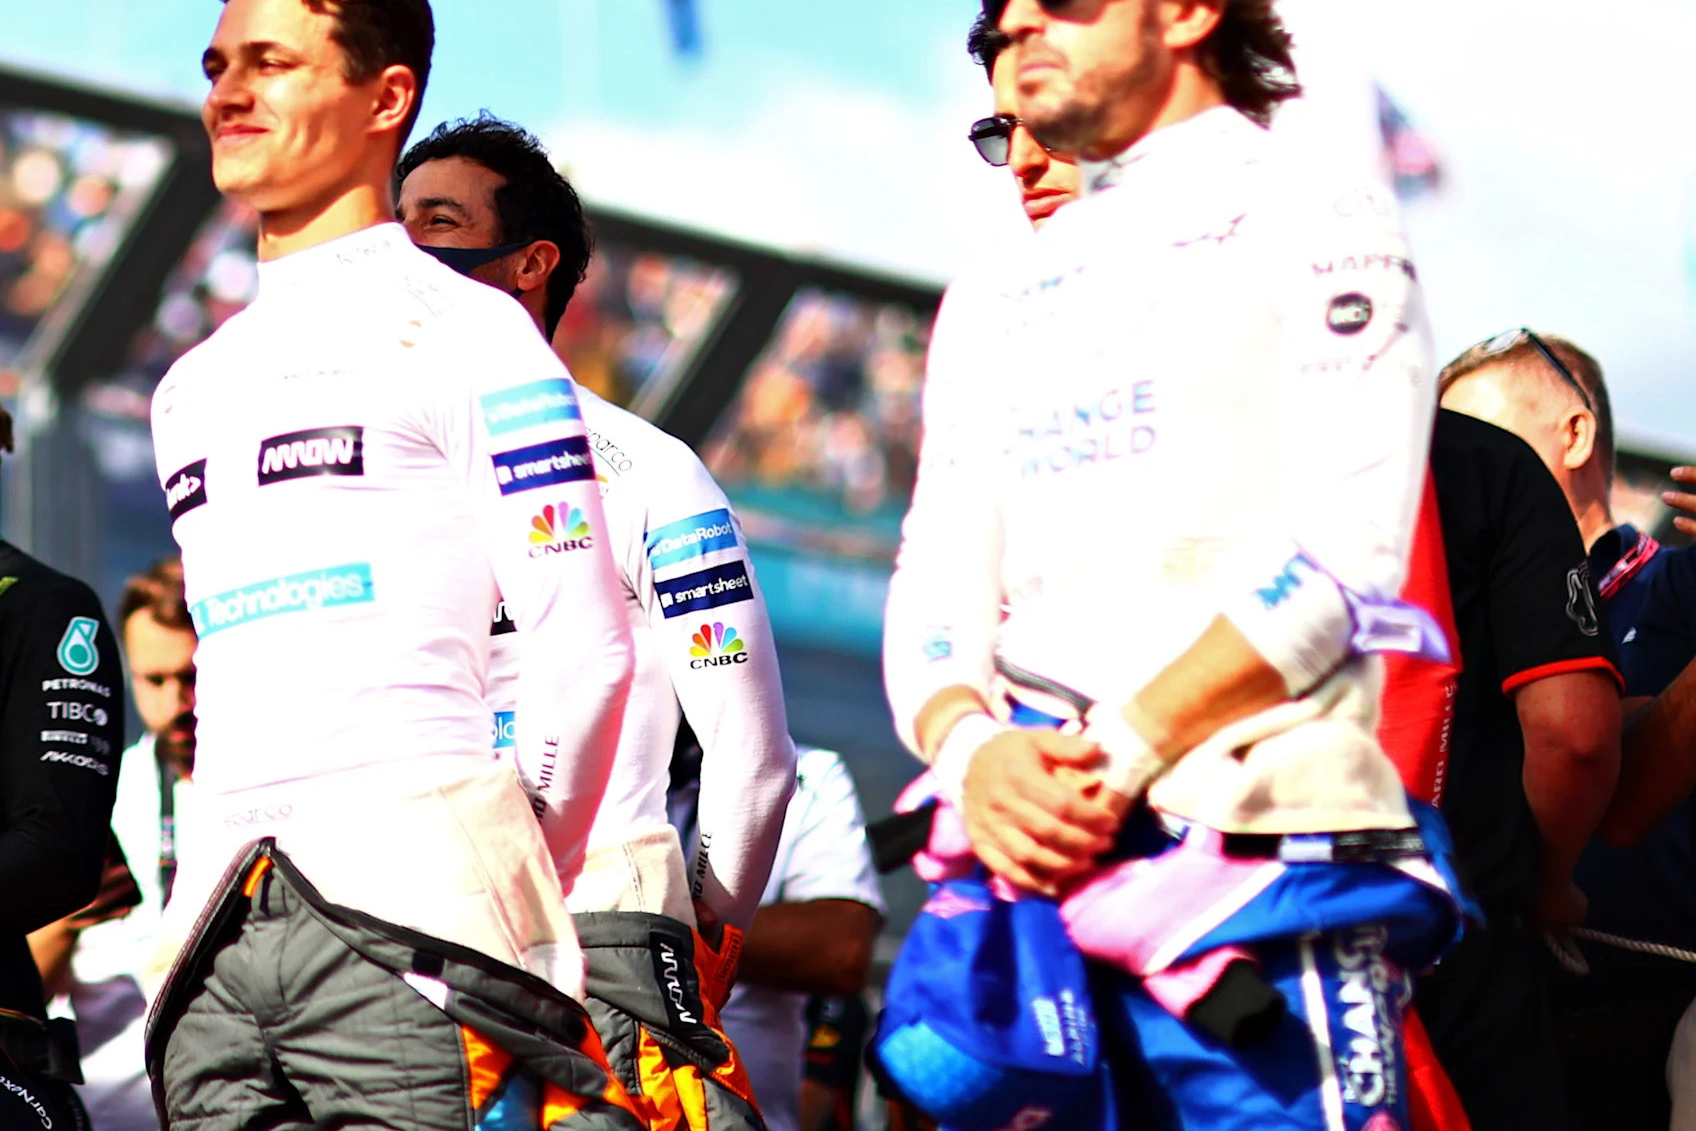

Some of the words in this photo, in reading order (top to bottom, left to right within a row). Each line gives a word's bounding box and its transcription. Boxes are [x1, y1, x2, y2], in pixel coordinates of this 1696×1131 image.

[528, 536, 594, 559] CNBC
[661, 521, 733, 554] DataRobot
[207, 573, 365, 627] Technologies
[675, 574, 748, 602] smartsheet
[690, 651, 749, 671] CNBC
